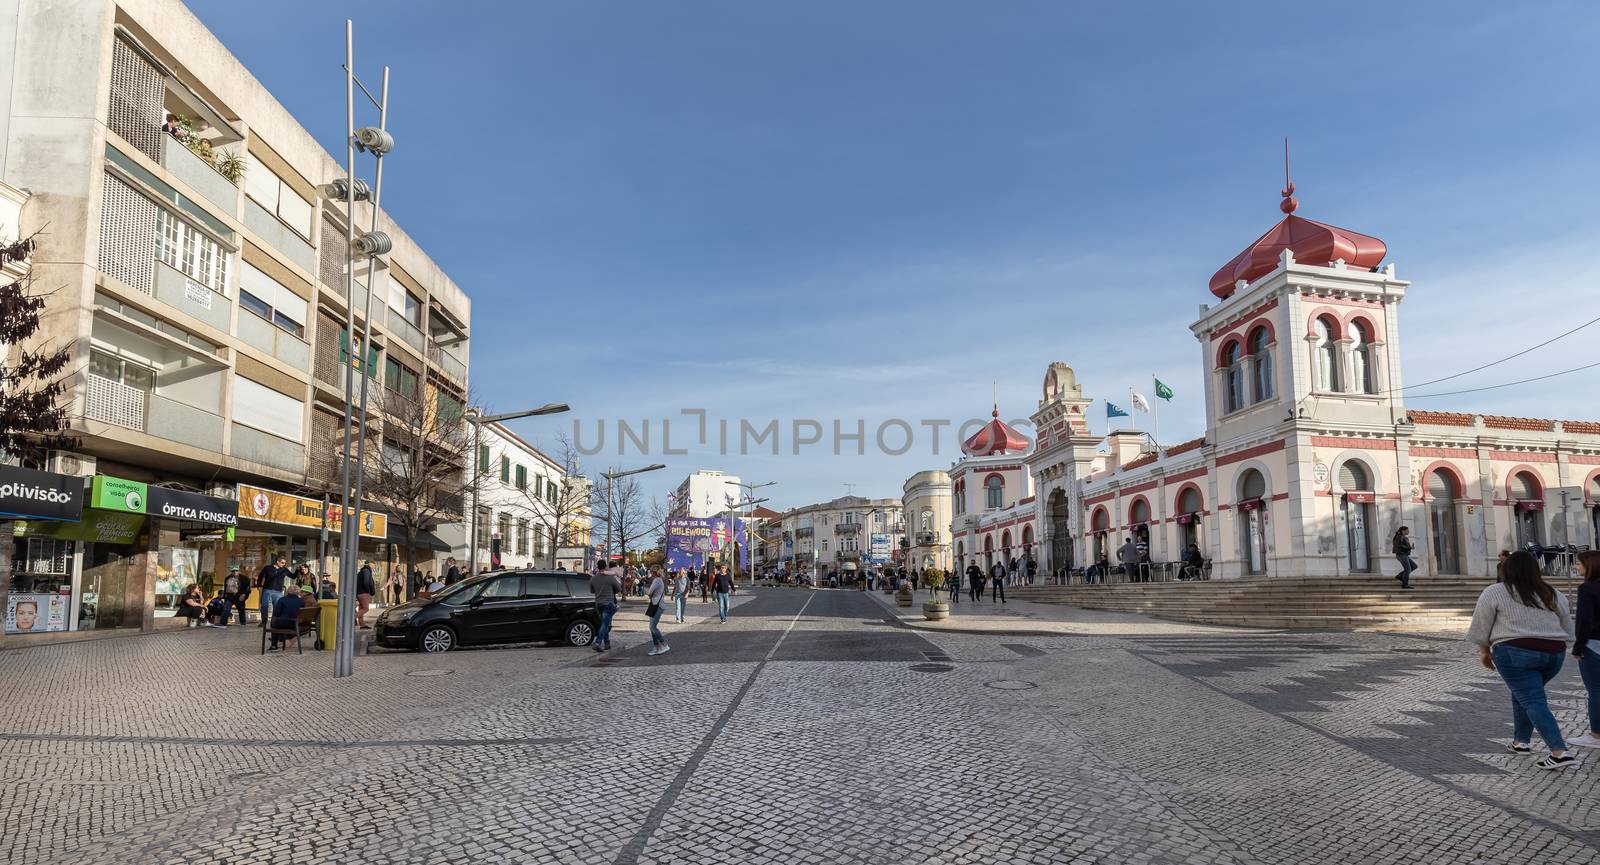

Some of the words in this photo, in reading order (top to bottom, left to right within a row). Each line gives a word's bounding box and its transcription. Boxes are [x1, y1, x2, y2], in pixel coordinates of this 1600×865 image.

[0, 482, 71, 504] ptivisão
[162, 502, 197, 519] ÓPTICA
[199, 509, 238, 525] FONSECA
